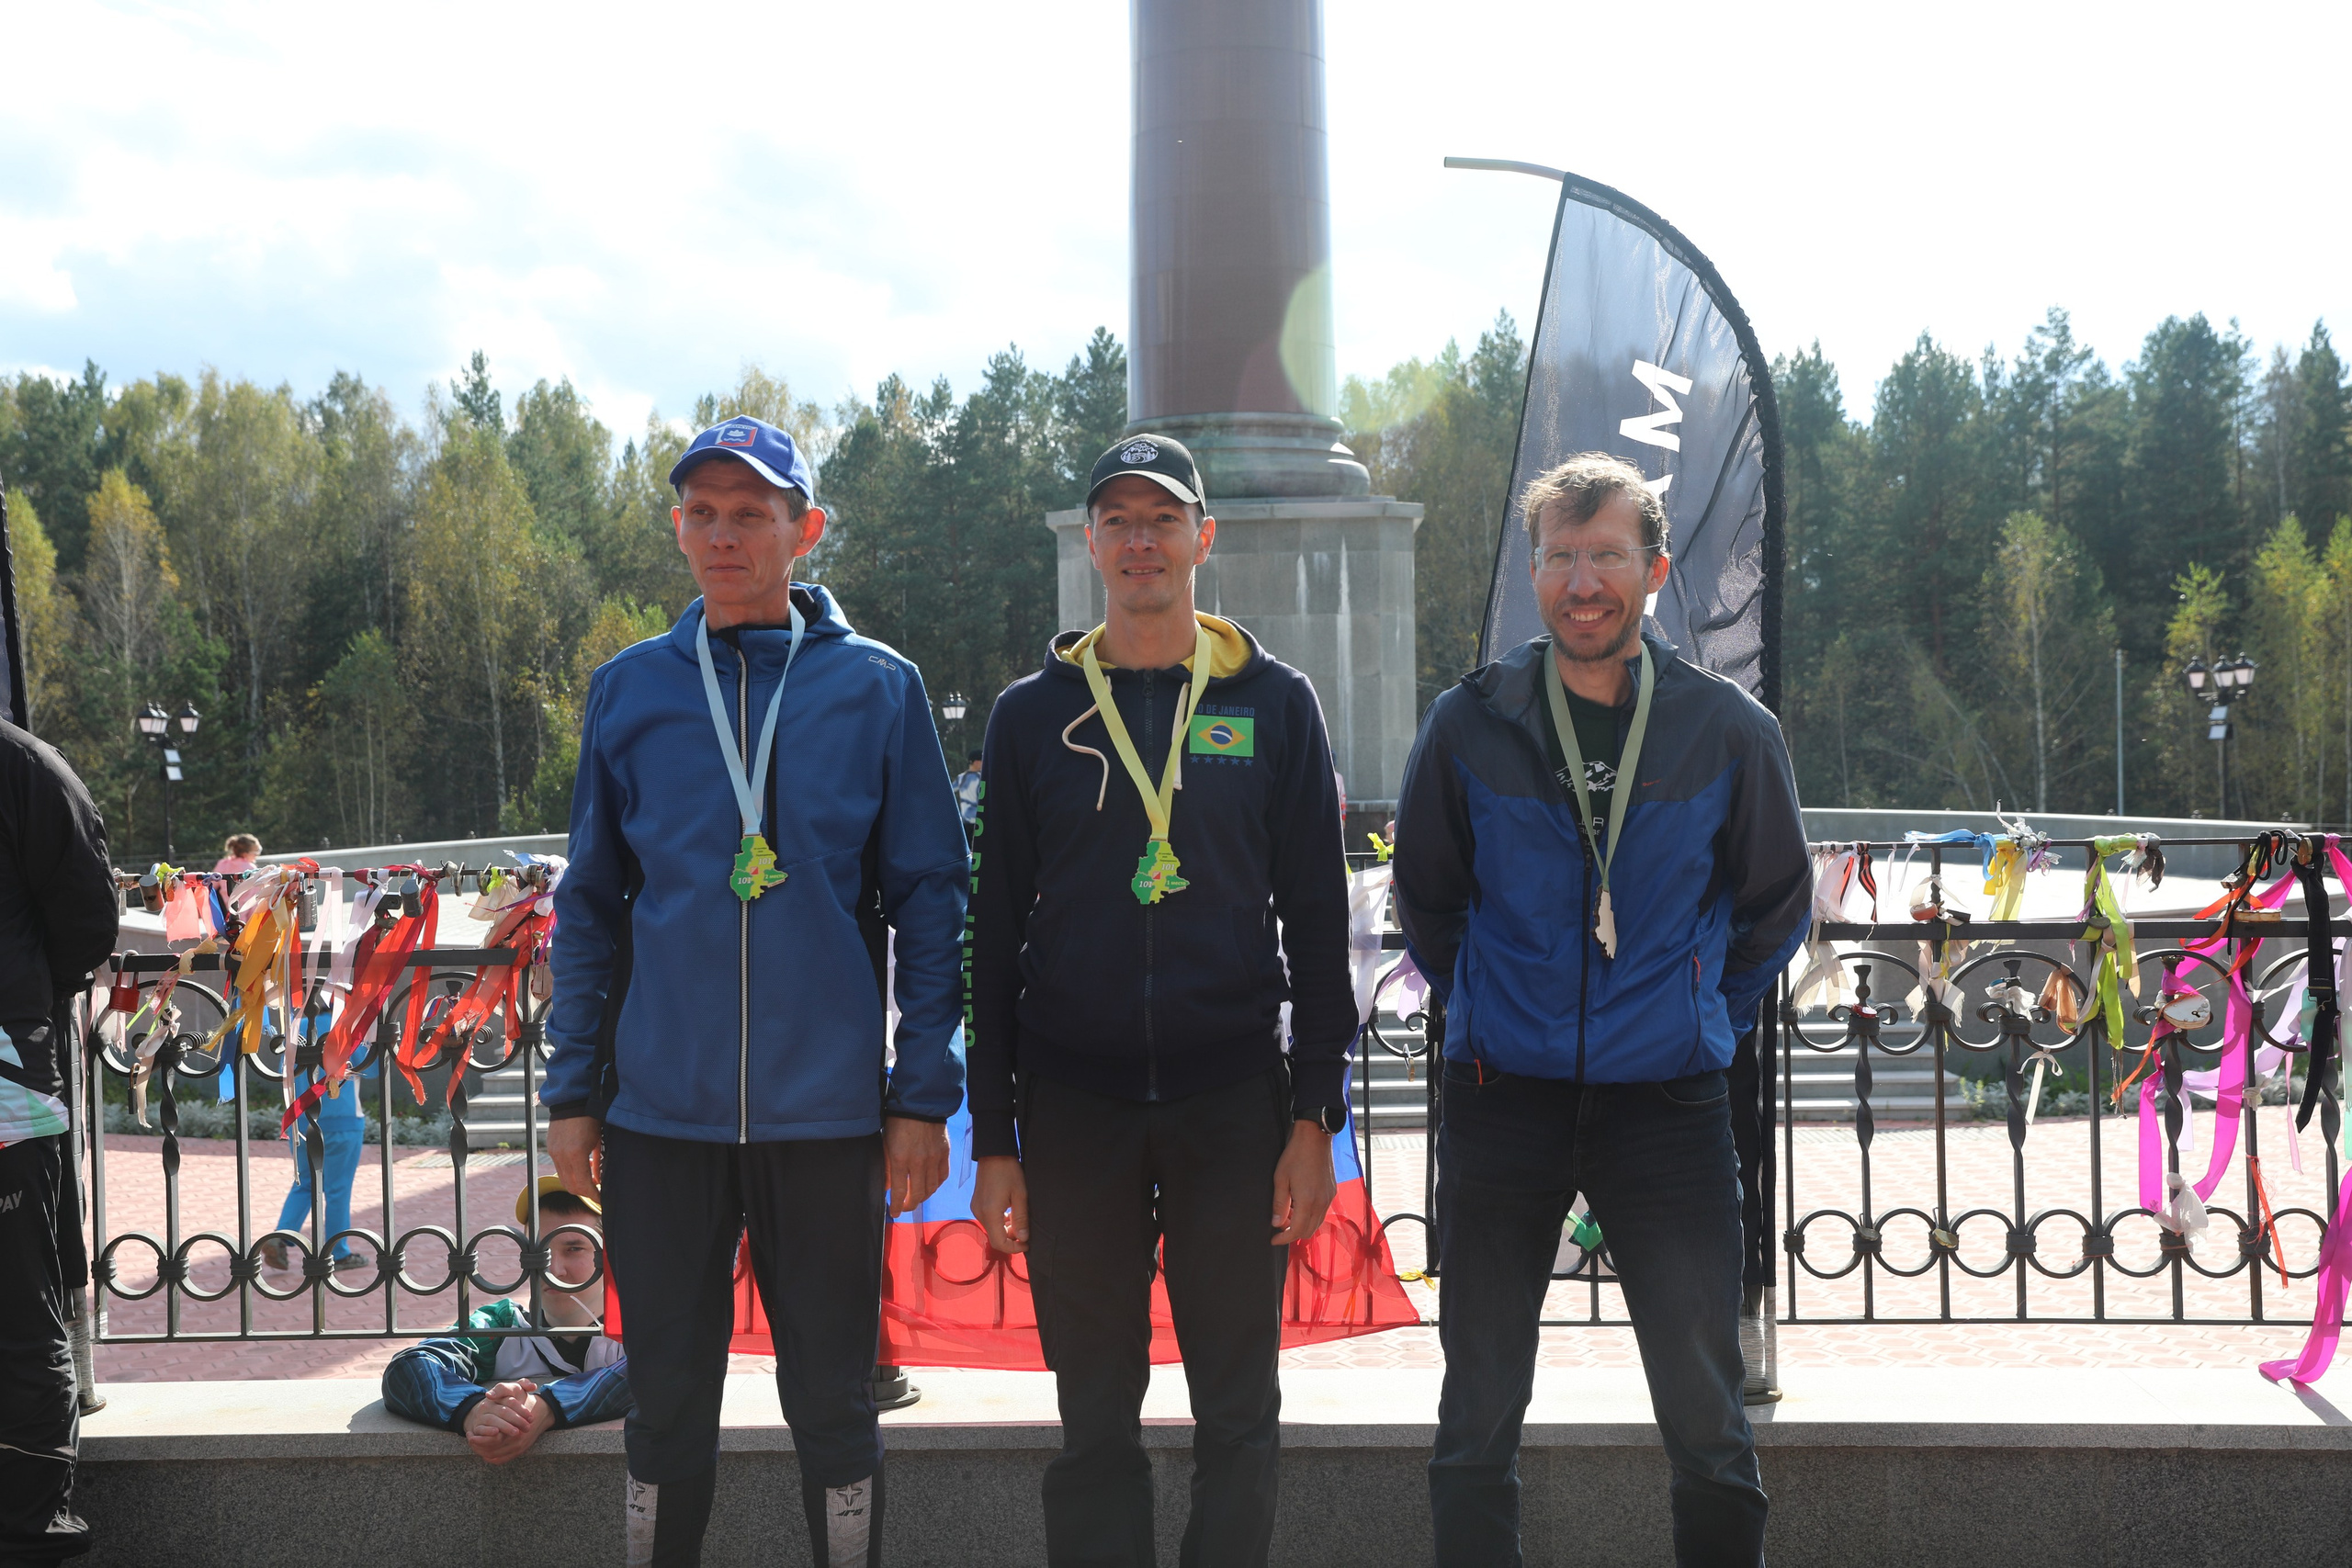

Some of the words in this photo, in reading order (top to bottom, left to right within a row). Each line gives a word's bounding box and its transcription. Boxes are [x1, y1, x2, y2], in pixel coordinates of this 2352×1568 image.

[868, 655, 897, 671] CMP
[1205, 704, 1217, 715] DE
[1219, 705, 1255, 717] JANEIRO
